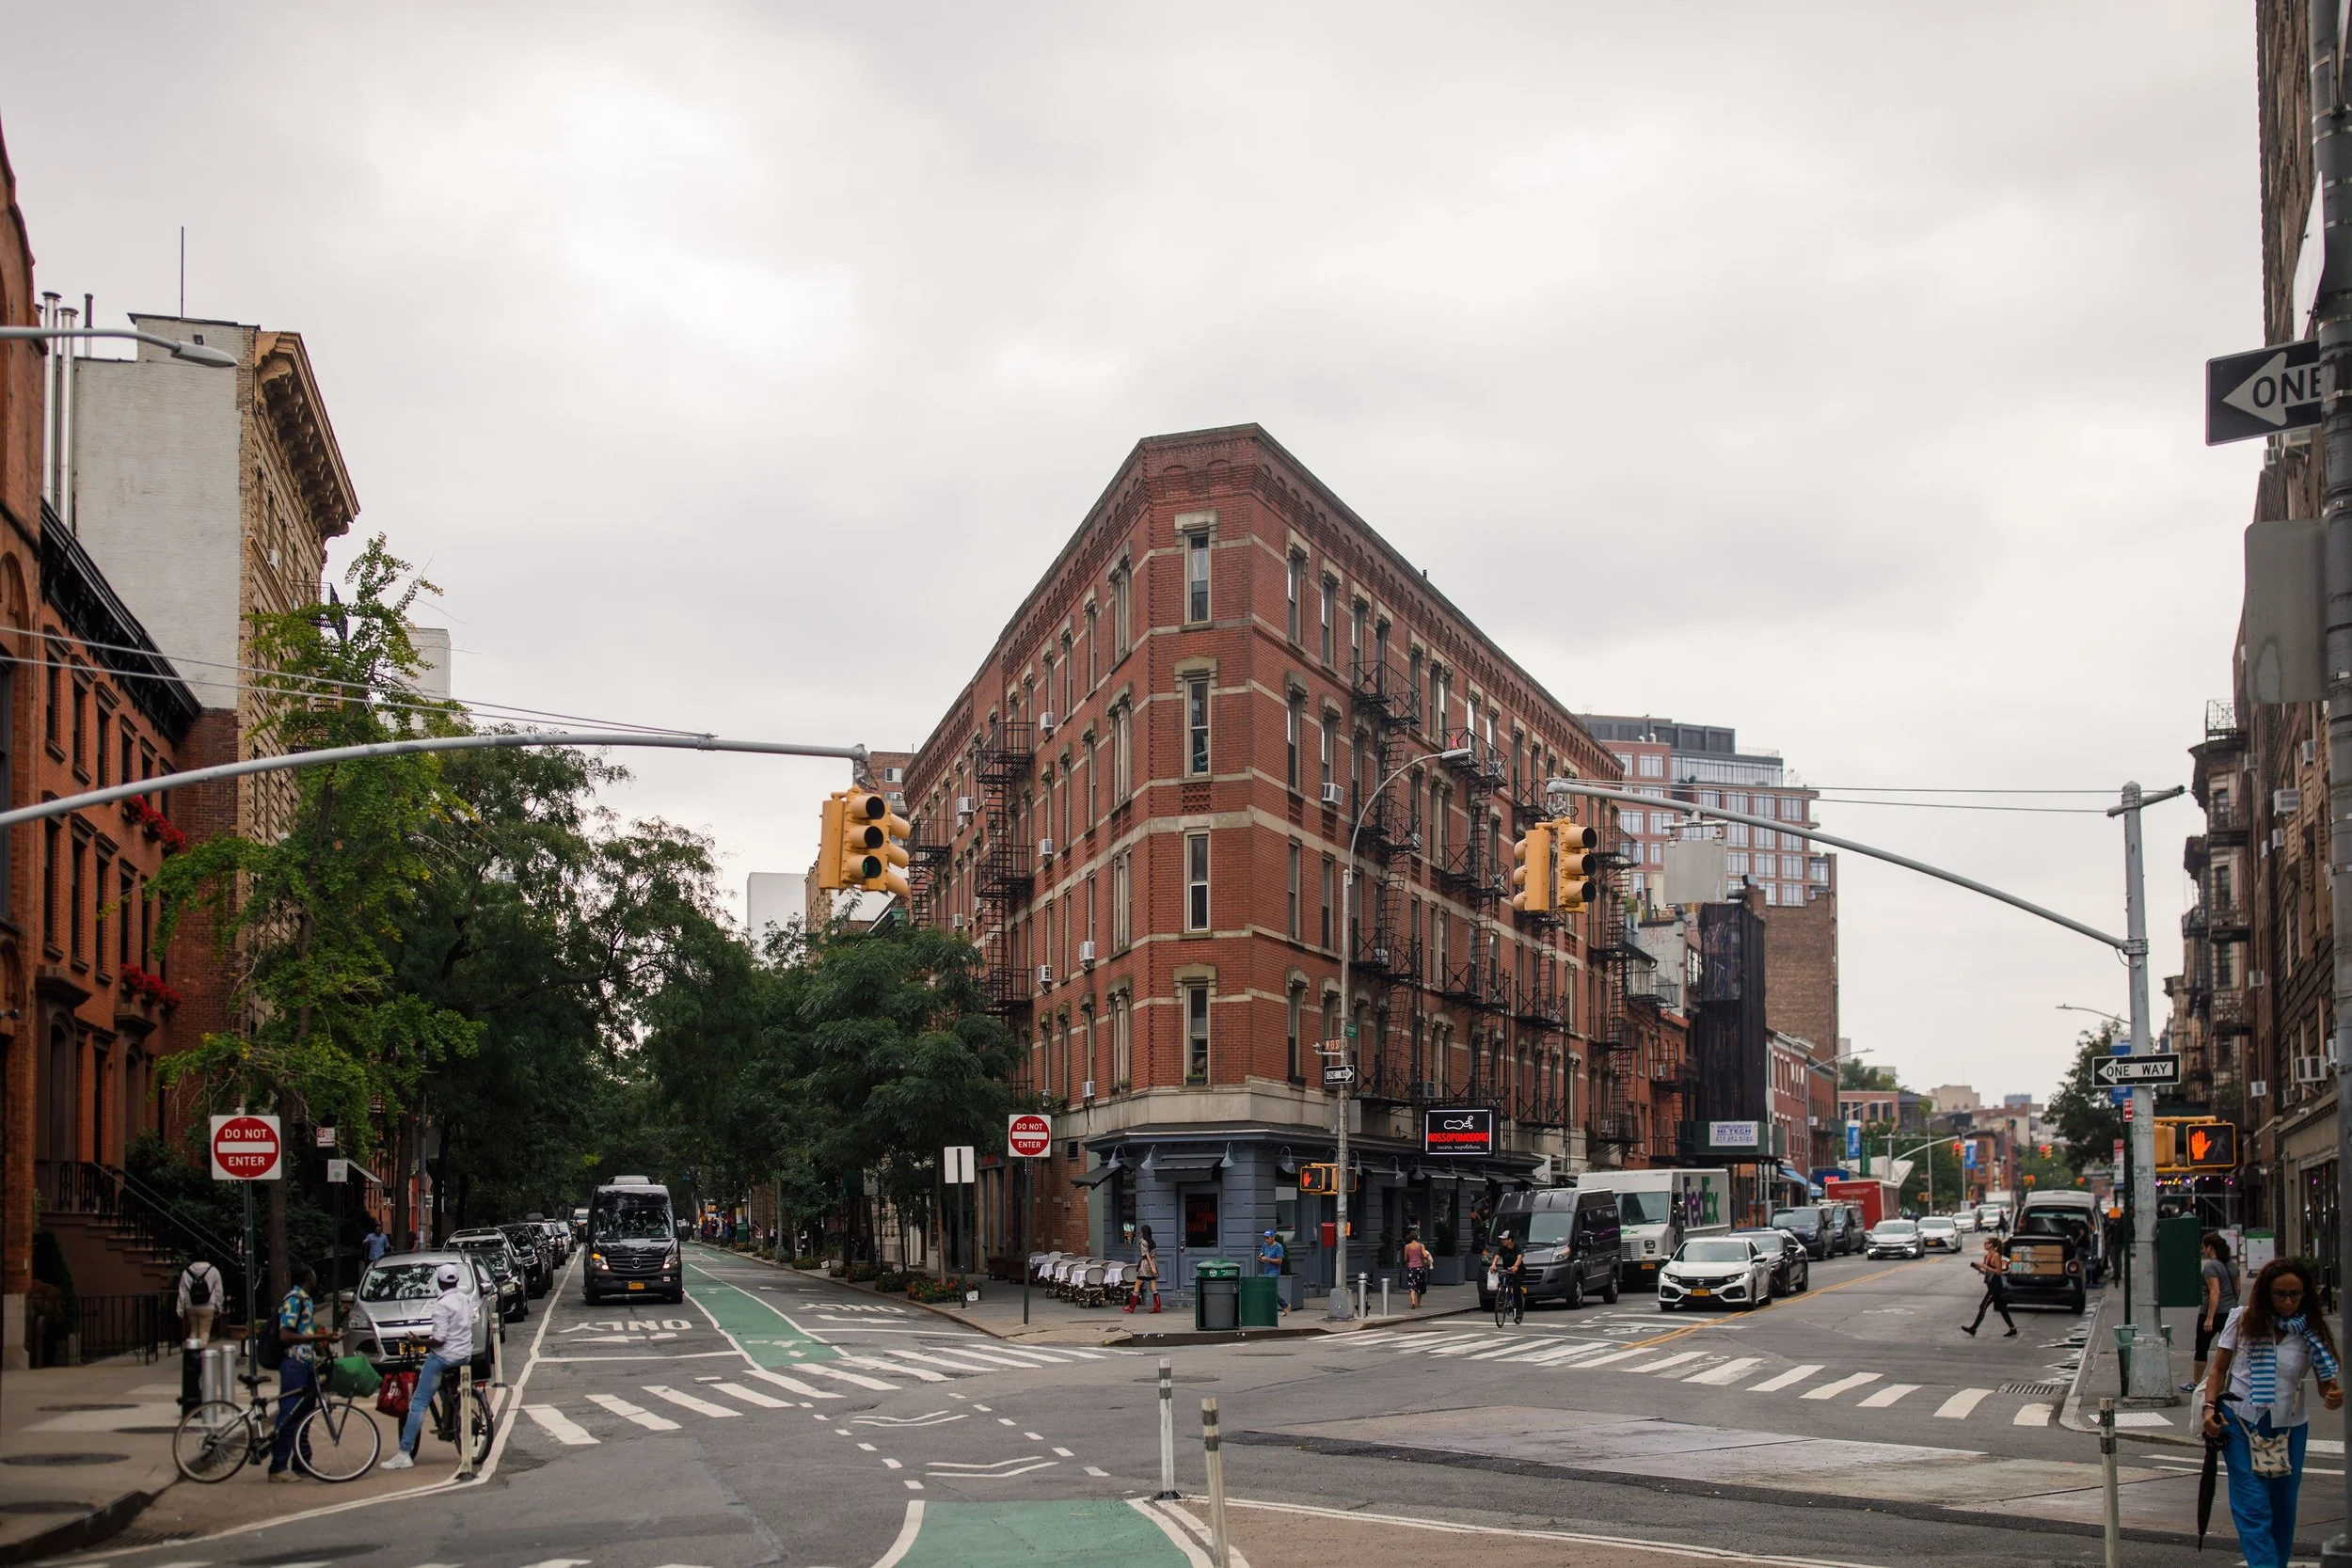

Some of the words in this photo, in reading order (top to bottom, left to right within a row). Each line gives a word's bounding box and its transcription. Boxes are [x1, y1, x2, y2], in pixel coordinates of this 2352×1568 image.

[2252, 367, 2321, 408] ONE
[2106, 1065, 2130, 1077] ONE
[2141, 1064, 2169, 1076] WAY
[225, 1129, 240, 1139] DO
[245, 1129, 267, 1139] NOT
[1428, 1132, 1489, 1143] ROSSOPOMODORO
[228, 1156, 265, 1166] ENTER
[1683, 1176, 1720, 1227] FedEx
[797, 1304, 906, 1313] ONLY
[558, 1319, 693, 1333] ONLY
